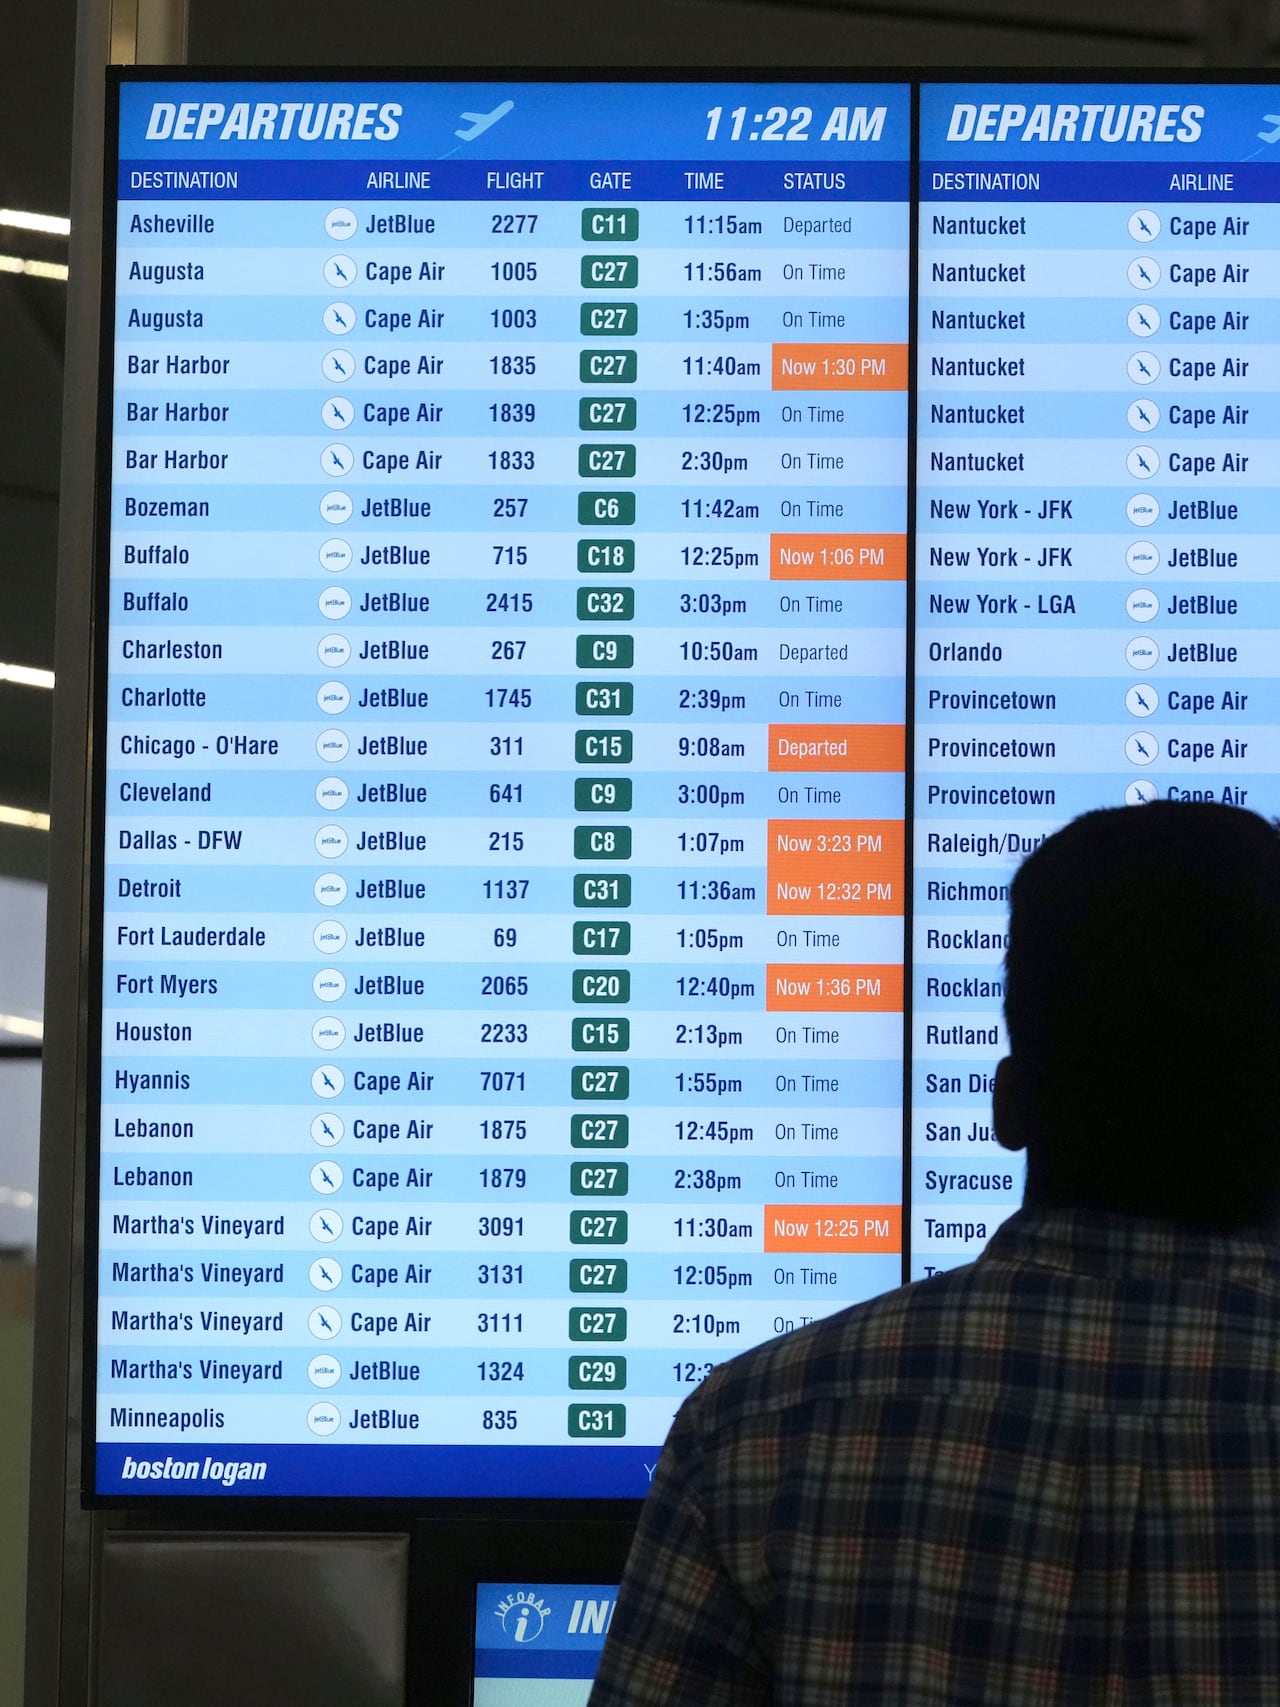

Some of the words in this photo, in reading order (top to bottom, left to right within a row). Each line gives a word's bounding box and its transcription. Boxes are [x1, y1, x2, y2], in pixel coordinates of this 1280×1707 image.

[145, 101, 403, 141] DEPARTURES
[706, 106, 813, 141] 11:22
[820, 106, 888, 142] AM
[946, 103, 1205, 143] DEPARTURES
[131, 171, 238, 189] DESTINATION
[366, 170, 431, 189] AIRLINE
[487, 171, 545, 189] FLIGHT
[589, 171, 632, 190] GATE
[683, 172, 724, 191] TIME
[783, 171, 846, 190] STATUS
[932, 172, 1040, 191] DESTINATION
[1169, 172, 1234, 191] AIRLINE
[932, 262, 1026, 283] Nantucket
[1169, 263, 1216, 287] Cape
[1222, 263, 1250, 283] Air
[127, 355, 160, 375] Bar
[166, 355, 230, 375] Harbor
[364, 355, 411, 379] Cape
[417, 355, 444, 375] Air
[489, 355, 536, 375] 1835
[590, 355, 627, 376] C27
[682, 356, 761, 376] 11:40am
[781, 358, 817, 376] Now
[822, 358, 856, 376] 1:30
[861, 358, 886, 376] PM
[929, 594, 970, 614] New
[976, 594, 1018, 614] York
[1038, 594, 1076, 614] LGA
[1167, 595, 1238, 615] JetBlue
[120, 735, 195, 759] Chicago
[216, 735, 279, 755] O'Hare
[357, 735, 428, 756] JetBlue
[490, 736, 523, 756] 311
[585, 736, 622, 757] C15
[678, 737, 745, 757] 9:08am
[778, 738, 848, 760] Departed
[928, 785, 1056, 805] Provincetown
[1167, 787, 1213, 803] Cape
[1221, 787, 1248, 805] Air
[117, 926, 154, 946] Fort
[161, 926, 266, 947] Lauderdale
[354, 927, 425, 947] JetBlue
[494, 927, 517, 948] 69
[583, 927, 621, 948] C17
[676, 928, 743, 952] 1:05pm
[777, 930, 797, 947] On
[802, 930, 840, 947] Time
[924, 1219, 987, 1243] Tampa
[110, 1407, 225, 1432] Minneapolis
[348, 1409, 420, 1430] JetBlue
[482, 1410, 518, 1430] 835
[578, 1409, 613, 1431] C31
[494, 1592, 551, 1618] INFOBAR
